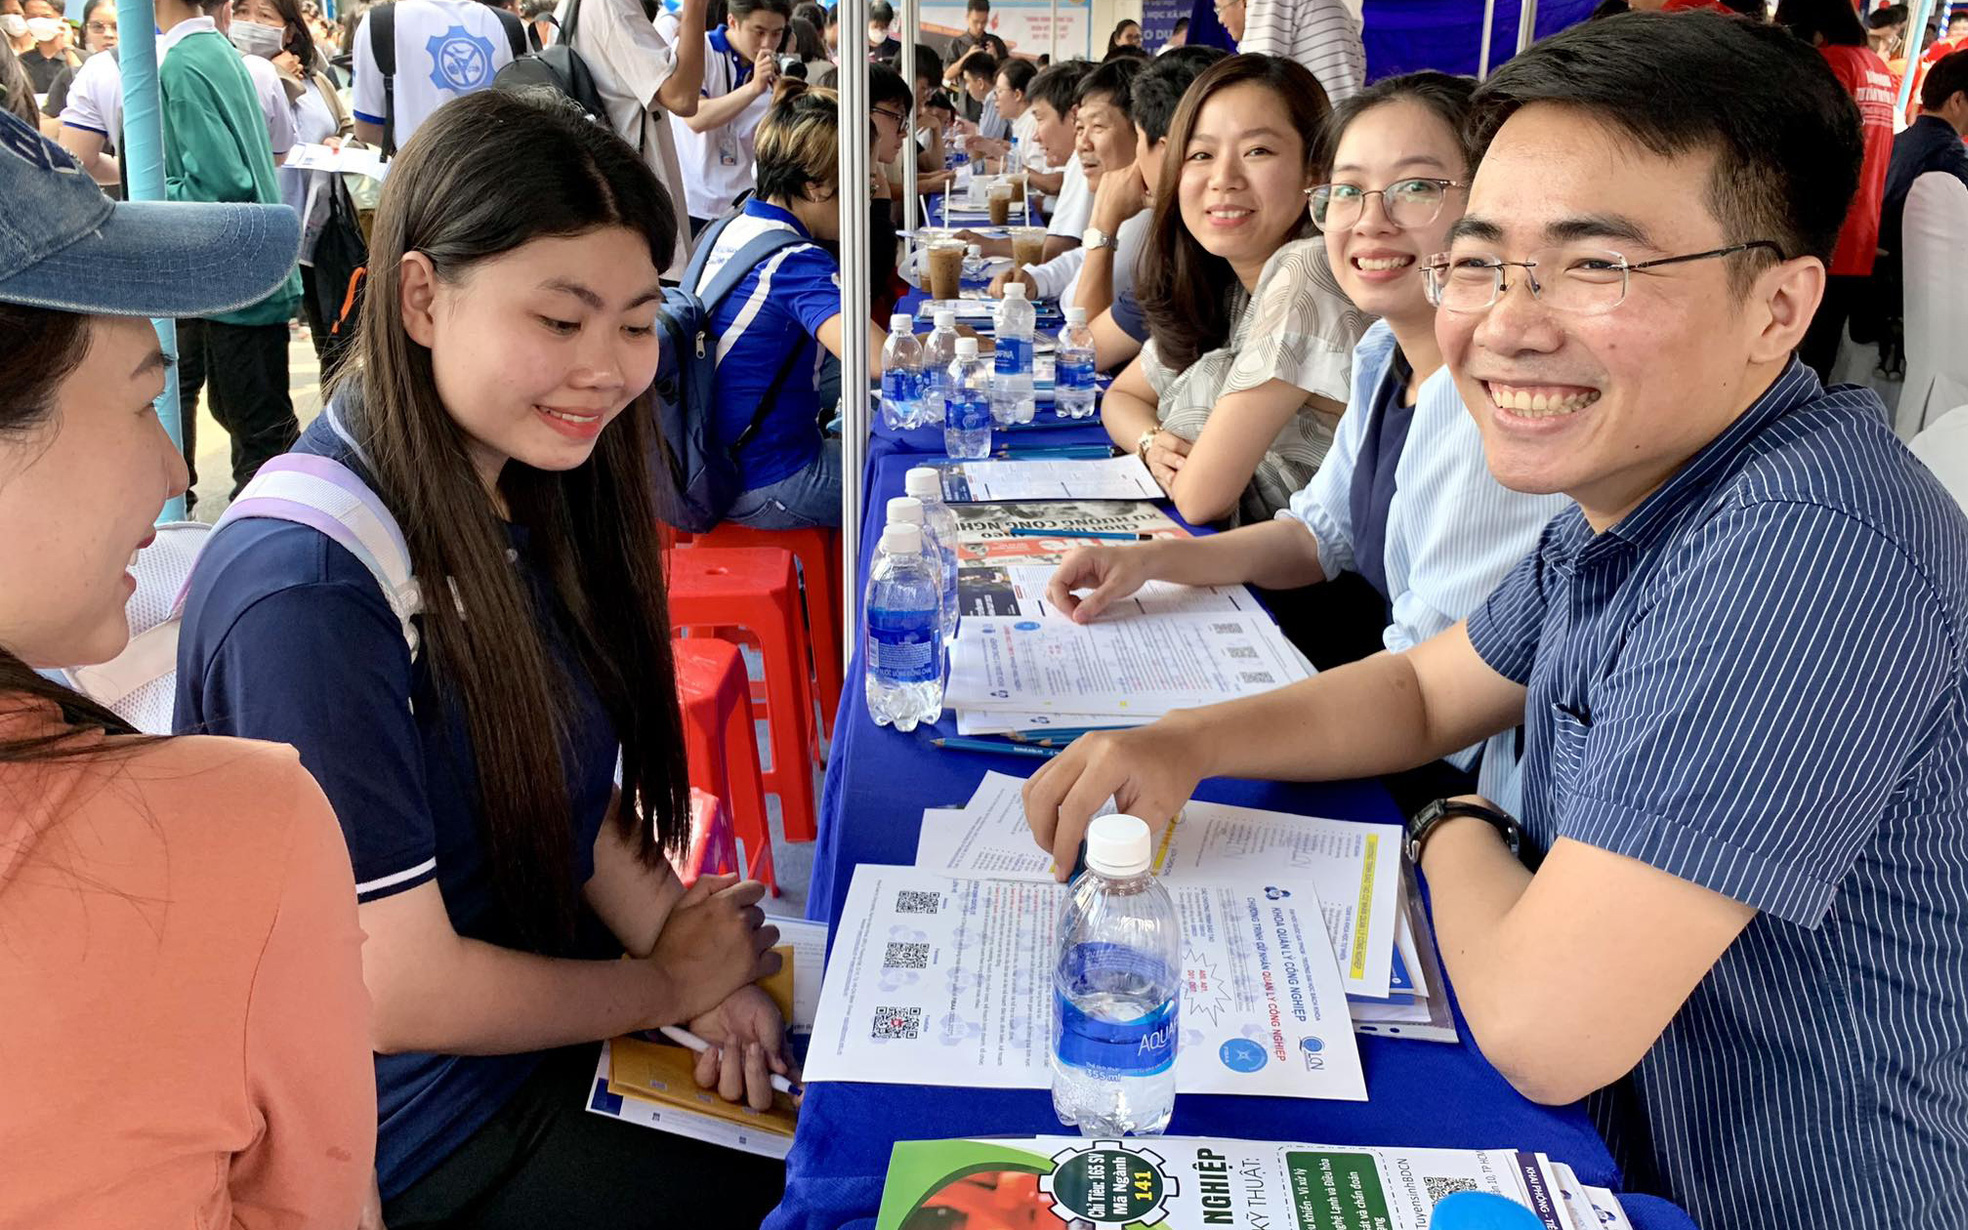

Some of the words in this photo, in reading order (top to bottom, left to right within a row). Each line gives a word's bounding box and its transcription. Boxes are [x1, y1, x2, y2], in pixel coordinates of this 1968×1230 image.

[1272, 908, 1285, 926] KHOA
[1284, 961, 1299, 985] CÔNG
[1290, 986, 1306, 1022] NGHIỆP
[1268, 1003, 1280, 1027] CÔNG
[1272, 1029, 1286, 1062] NGHIỆP
[1088, 1152, 1105, 1164] SV
[1088, 1164, 1105, 1180] 165
[1112, 1156, 1130, 1192] Ngành
[1525, 1166, 1539, 1184] KHAI
[1088, 1182, 1105, 1202] Tiêu:
[1134, 1171, 1152, 1200] 141
[1192, 1148, 1234, 1224] NGHIỆP
[1240, 1158, 1266, 1207] THUẬT:
[1086, 1202, 1106, 1218] Chỉ
[1112, 1196, 1128, 1215] Mã
[1326, 1196, 1342, 1214] Lạnh
[1355, 1210, 1368, 1219] và
